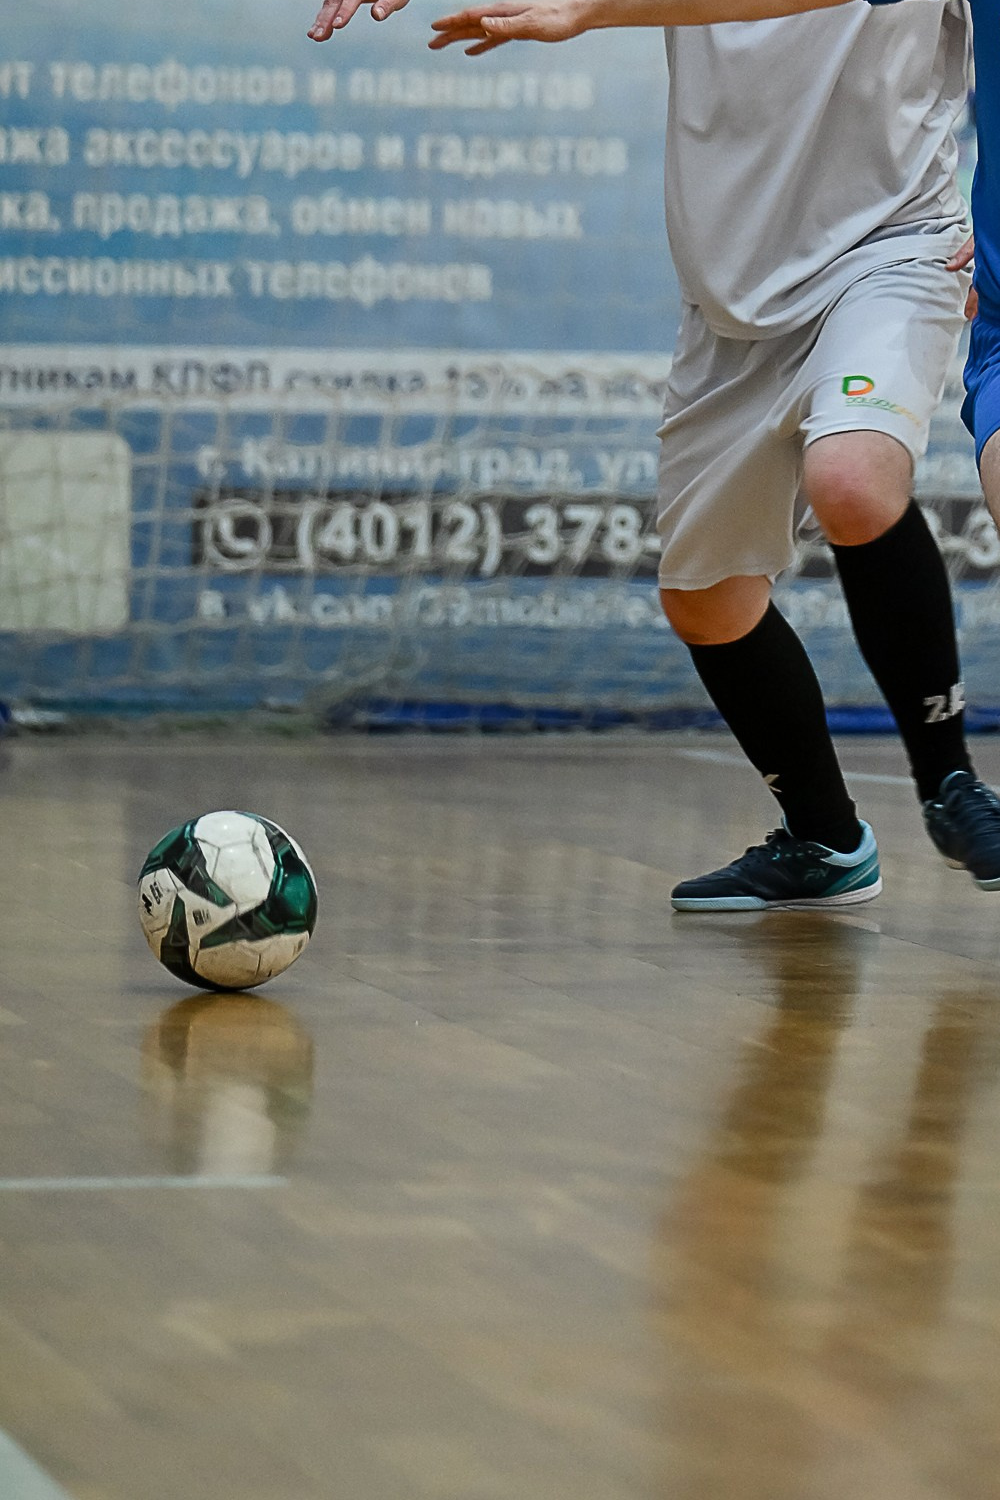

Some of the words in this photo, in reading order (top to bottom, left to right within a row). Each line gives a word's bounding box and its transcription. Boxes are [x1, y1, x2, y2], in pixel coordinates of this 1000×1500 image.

[50, 58, 294, 110] телефонов
[349, 66, 595, 108] планшетов
[85, 128, 363, 177] аксессуаров
[417, 135, 627, 176] гаджетов
[292, 187, 430, 237] обмен
[442, 200, 582, 239] новых
[248, 254, 493, 308] телефонов
[297, 499, 502, 577] (4012)
